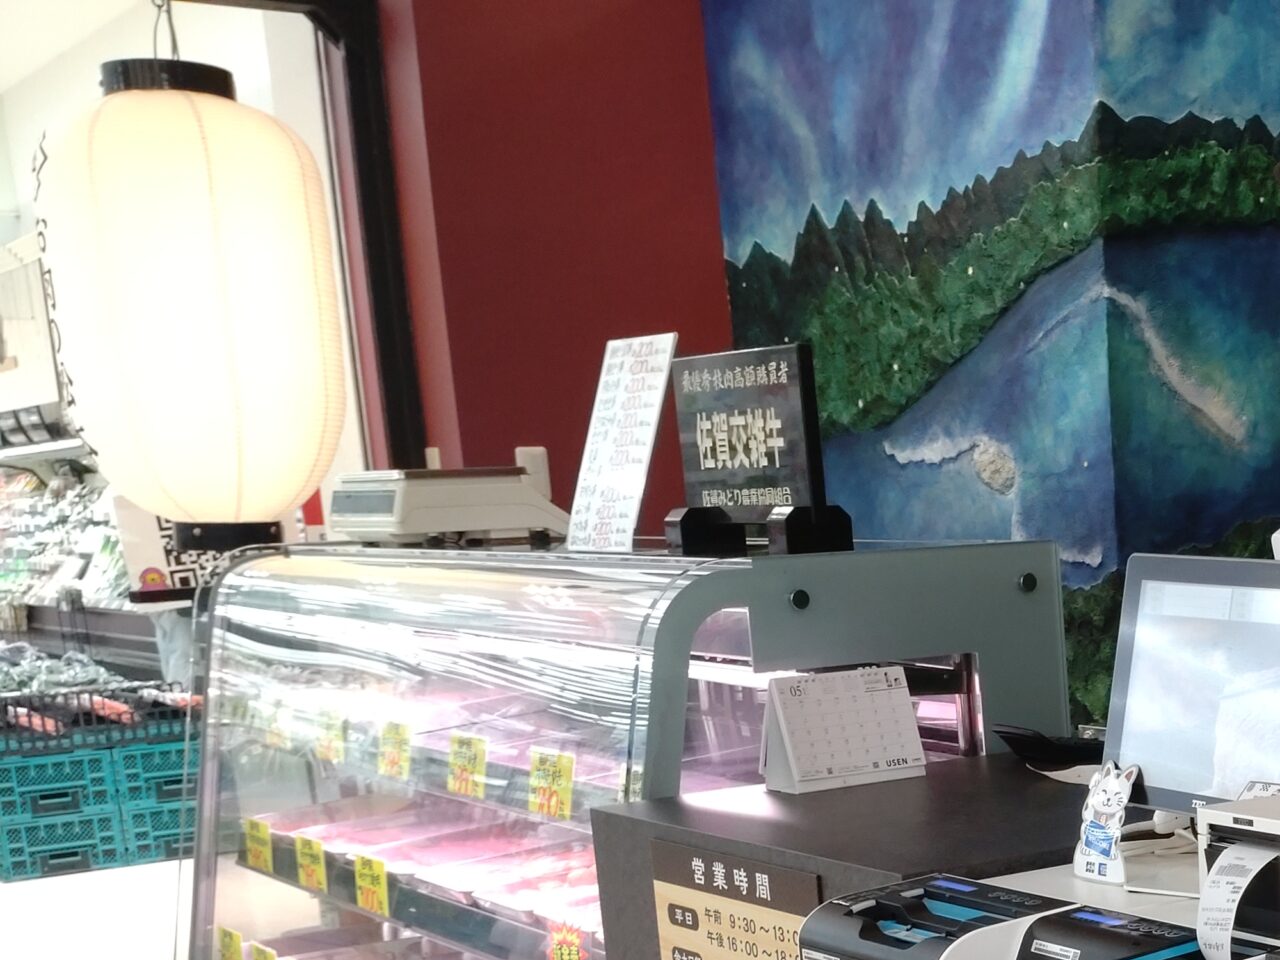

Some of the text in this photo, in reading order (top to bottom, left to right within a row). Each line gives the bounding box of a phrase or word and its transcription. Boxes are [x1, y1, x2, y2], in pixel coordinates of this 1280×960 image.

[696, 407, 785, 470] 佐賀交雑牛
[702, 486, 792, 507] 佐賀みどり農業協同組合
[885, 758, 908, 767] USEN
[691, 857, 771, 901] 営業時間
[674, 908, 693, 926] 平日
[704, 906, 722, 926] 午前
[706, 929, 725, 949] 午後
